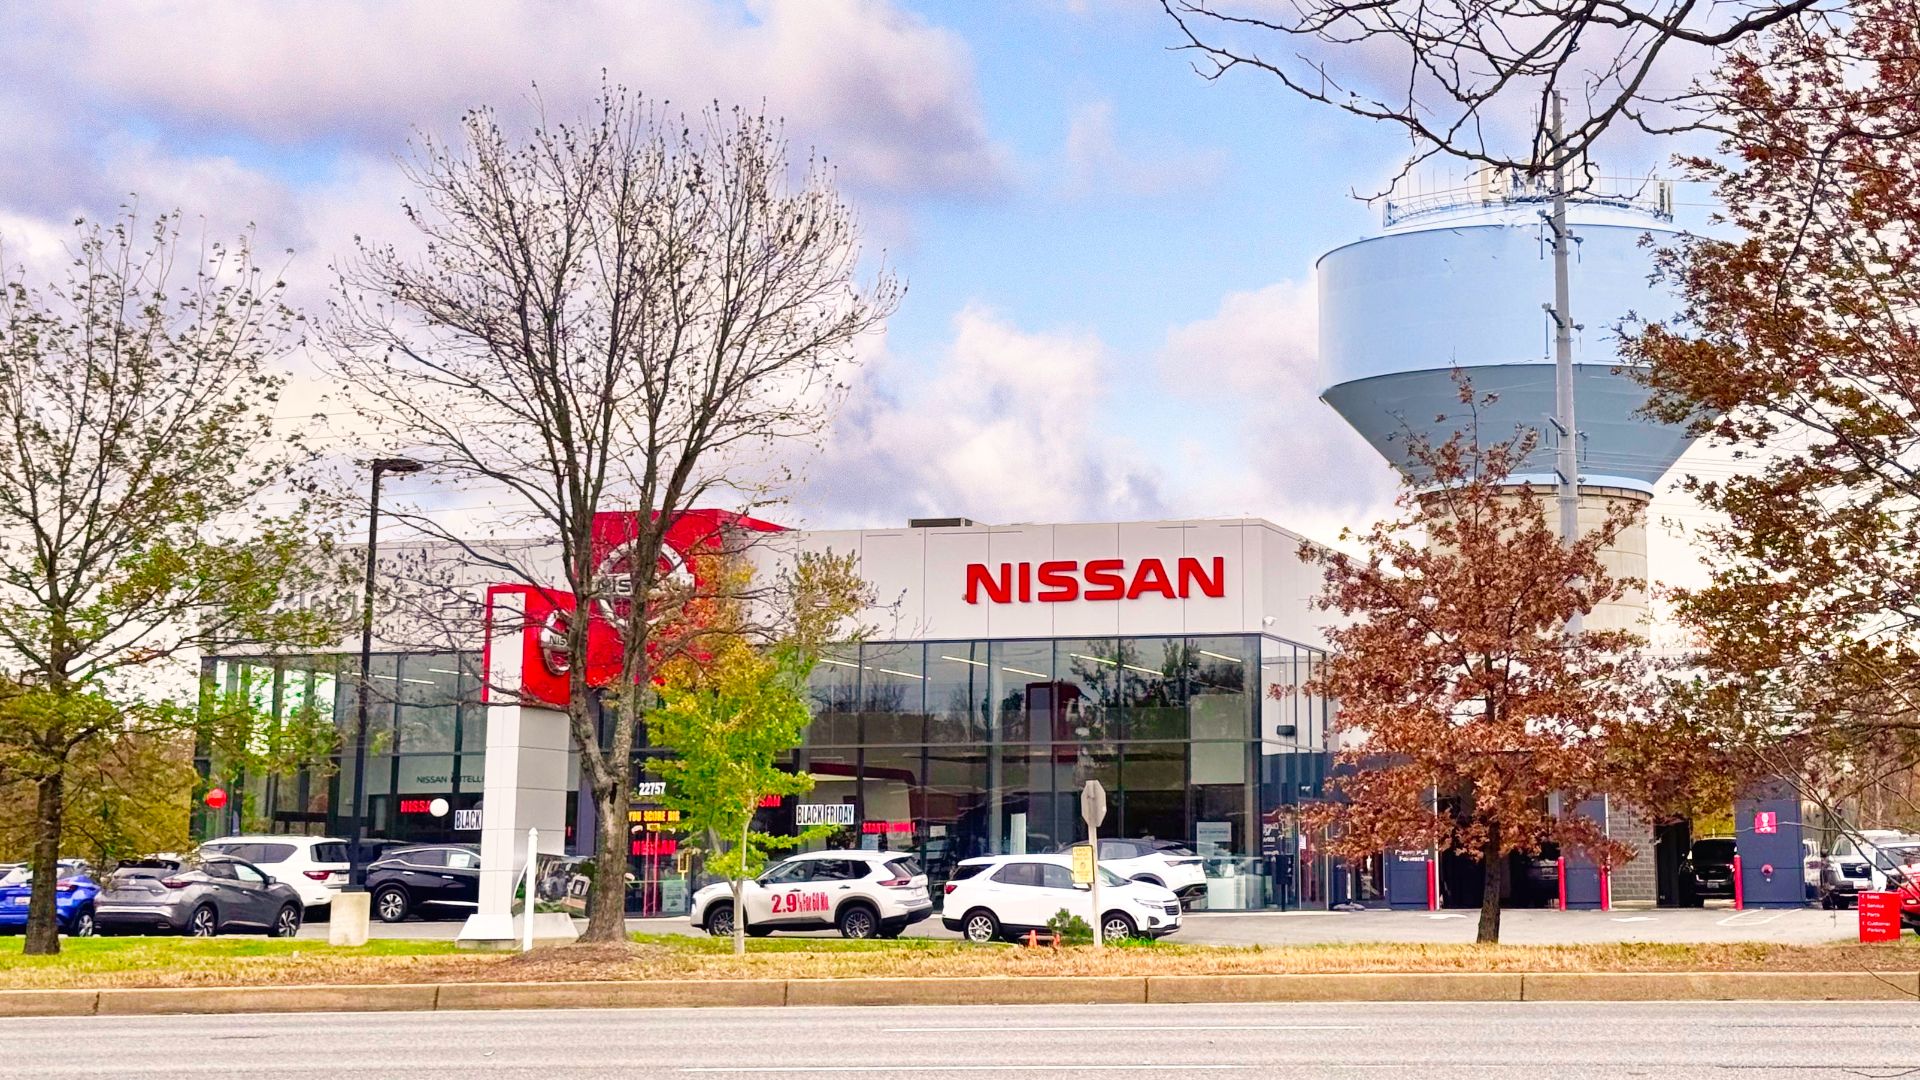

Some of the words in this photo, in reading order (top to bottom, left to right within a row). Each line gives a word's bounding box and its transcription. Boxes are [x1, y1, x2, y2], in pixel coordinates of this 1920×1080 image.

[966, 556, 1225, 604] NISSAN
[417, 776, 448, 784] NISSAN
[639, 782, 667, 796] 22757
[456, 811, 481, 829] BLACK
[628, 811, 642, 822] YOU
[643, 811, 666, 822] SCORE
[797, 806, 823, 825] BLACK
[826, 806, 853, 824] FRIDAY
